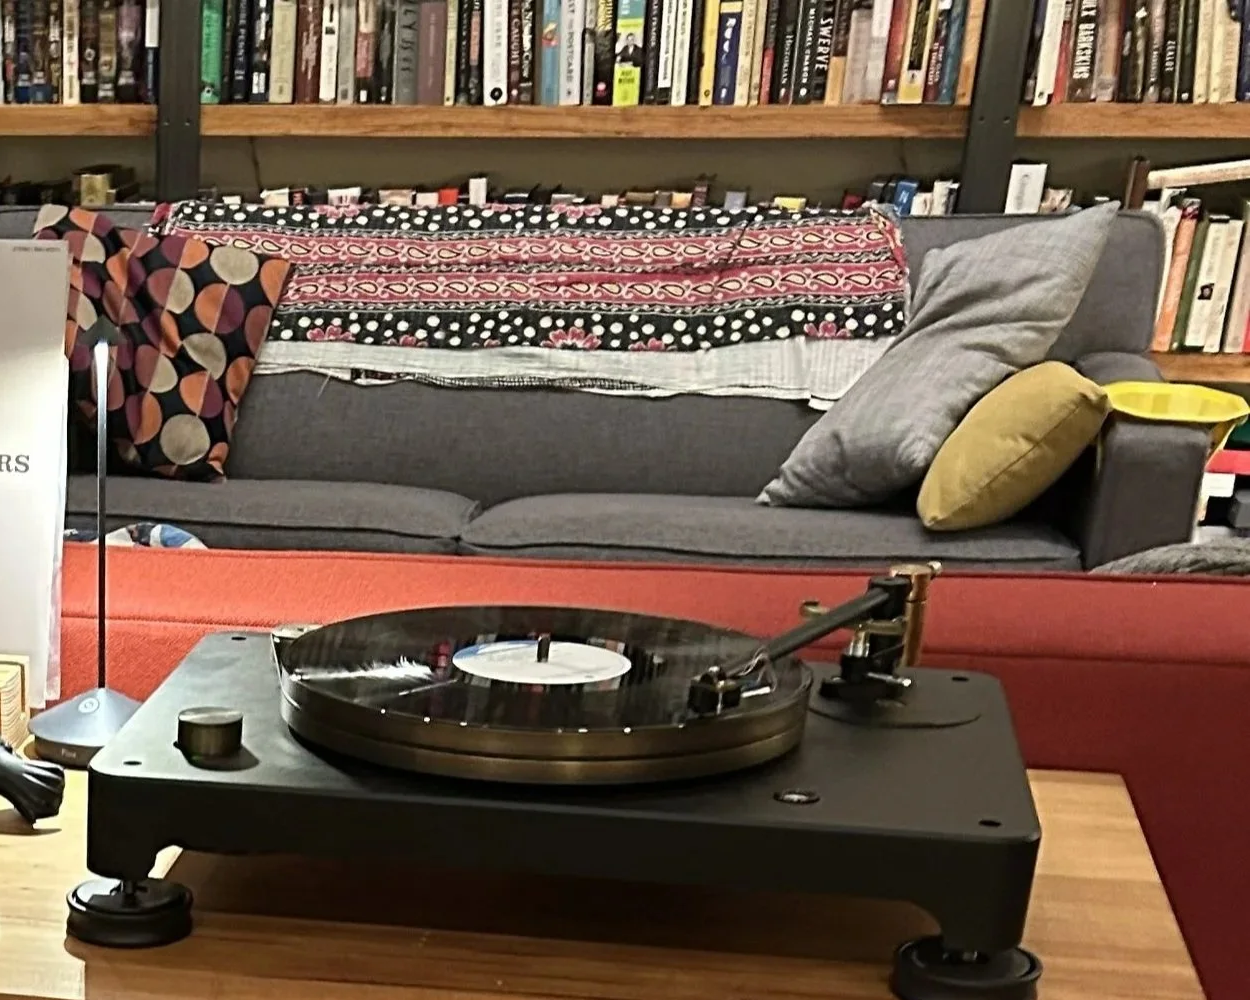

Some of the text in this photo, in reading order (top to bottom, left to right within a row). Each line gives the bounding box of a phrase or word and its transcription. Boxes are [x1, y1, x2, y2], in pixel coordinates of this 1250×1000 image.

[401, 0, 418, 71] LYSSES
[815, 17, 834, 71] SWERVE
[1072, 22, 1096, 80] BARKSKINS
